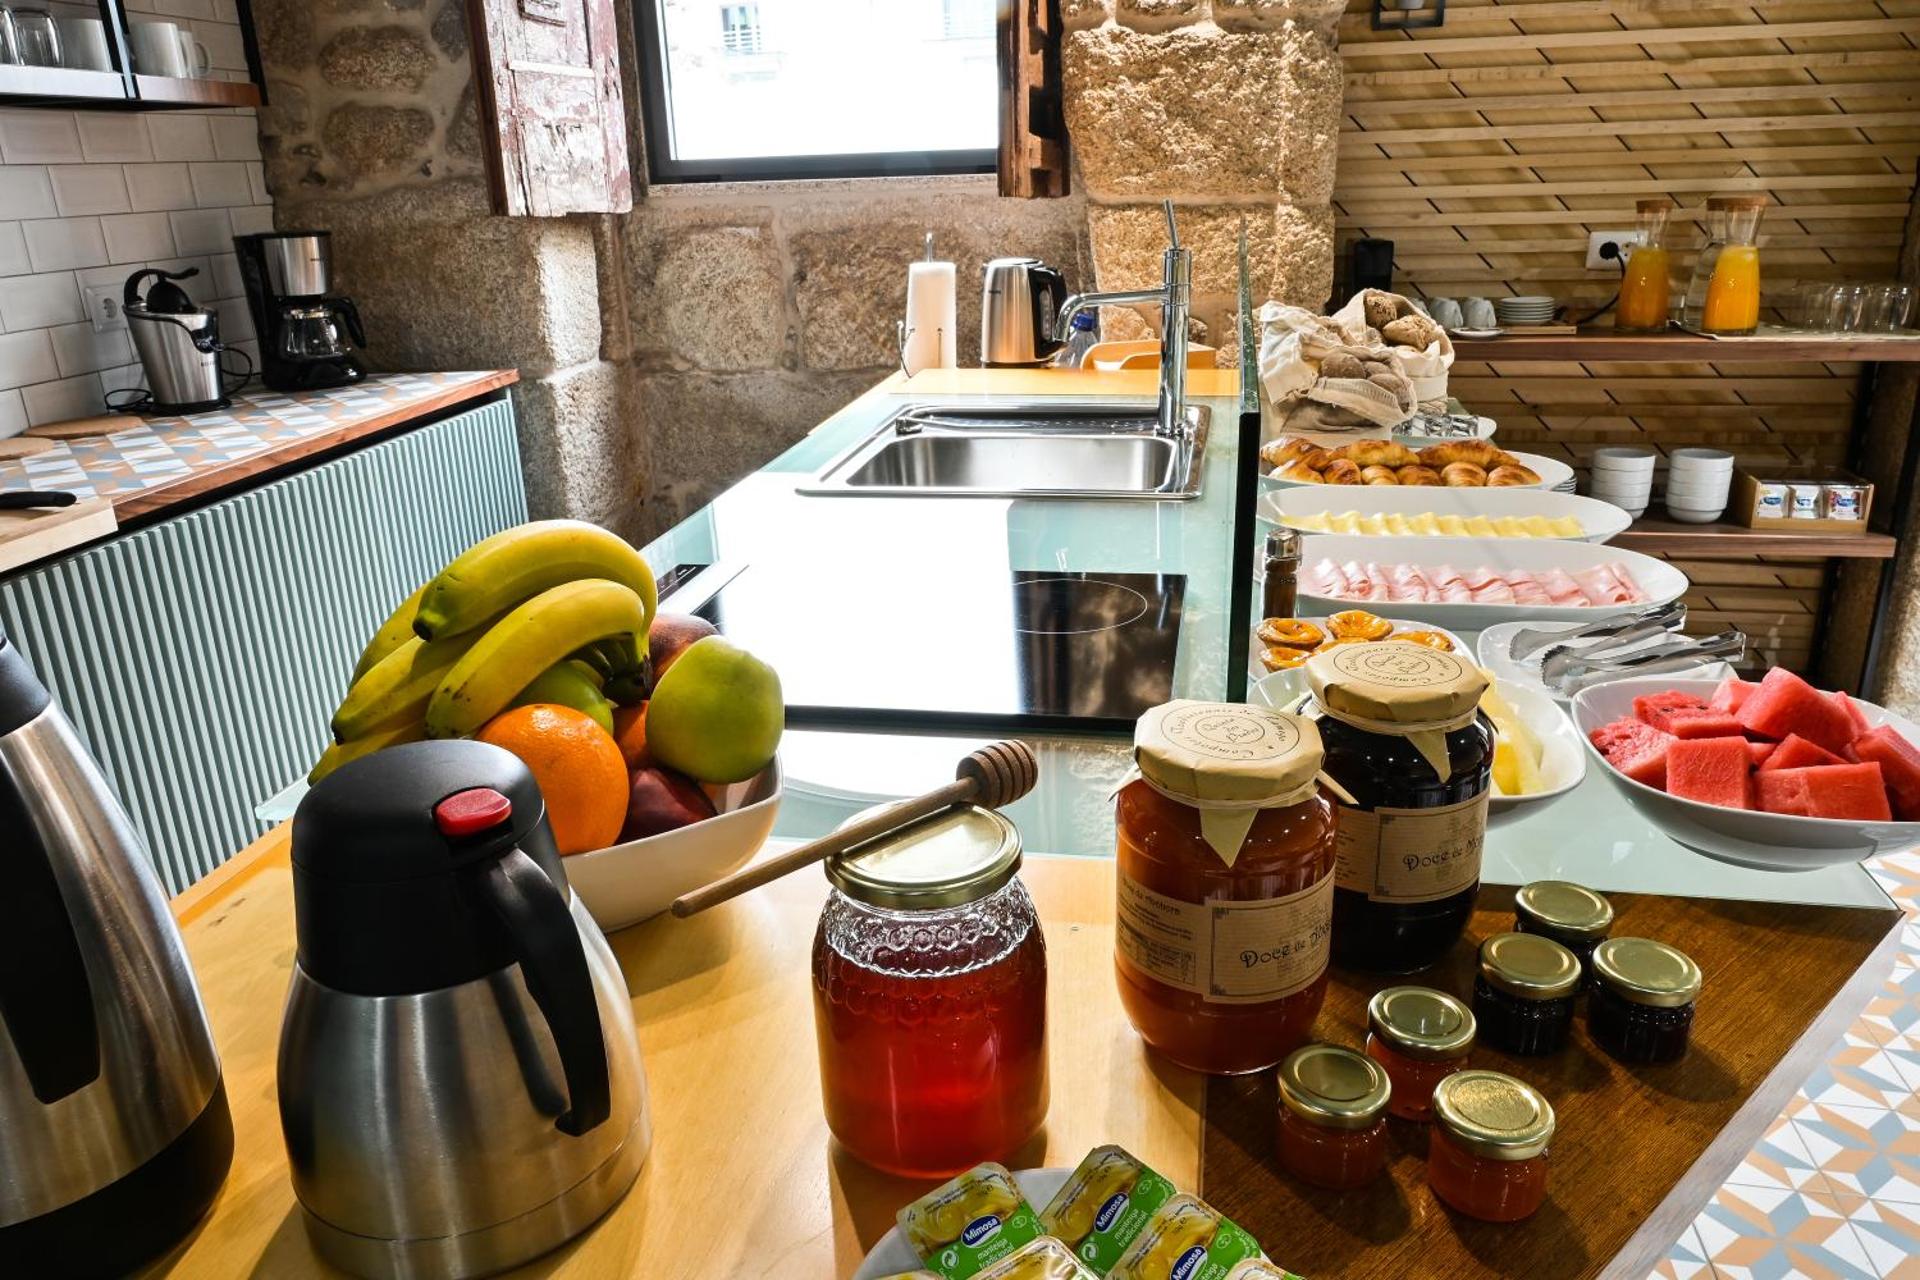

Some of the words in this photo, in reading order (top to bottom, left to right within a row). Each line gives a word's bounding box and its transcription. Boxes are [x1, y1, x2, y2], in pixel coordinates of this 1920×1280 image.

[1402, 850, 1449, 872] Doce
[1240, 944, 1290, 969] Doce
[1096, 1194, 1125, 1228] Mimosa
[1114, 1208, 1140, 1240] manteiga
[964, 1216, 999, 1242] Mimosa
[1118, 1209, 1149, 1248] tradicional
[977, 1237, 1009, 1261] manteiga
[1171, 1248, 1202, 1280] Mimosa
